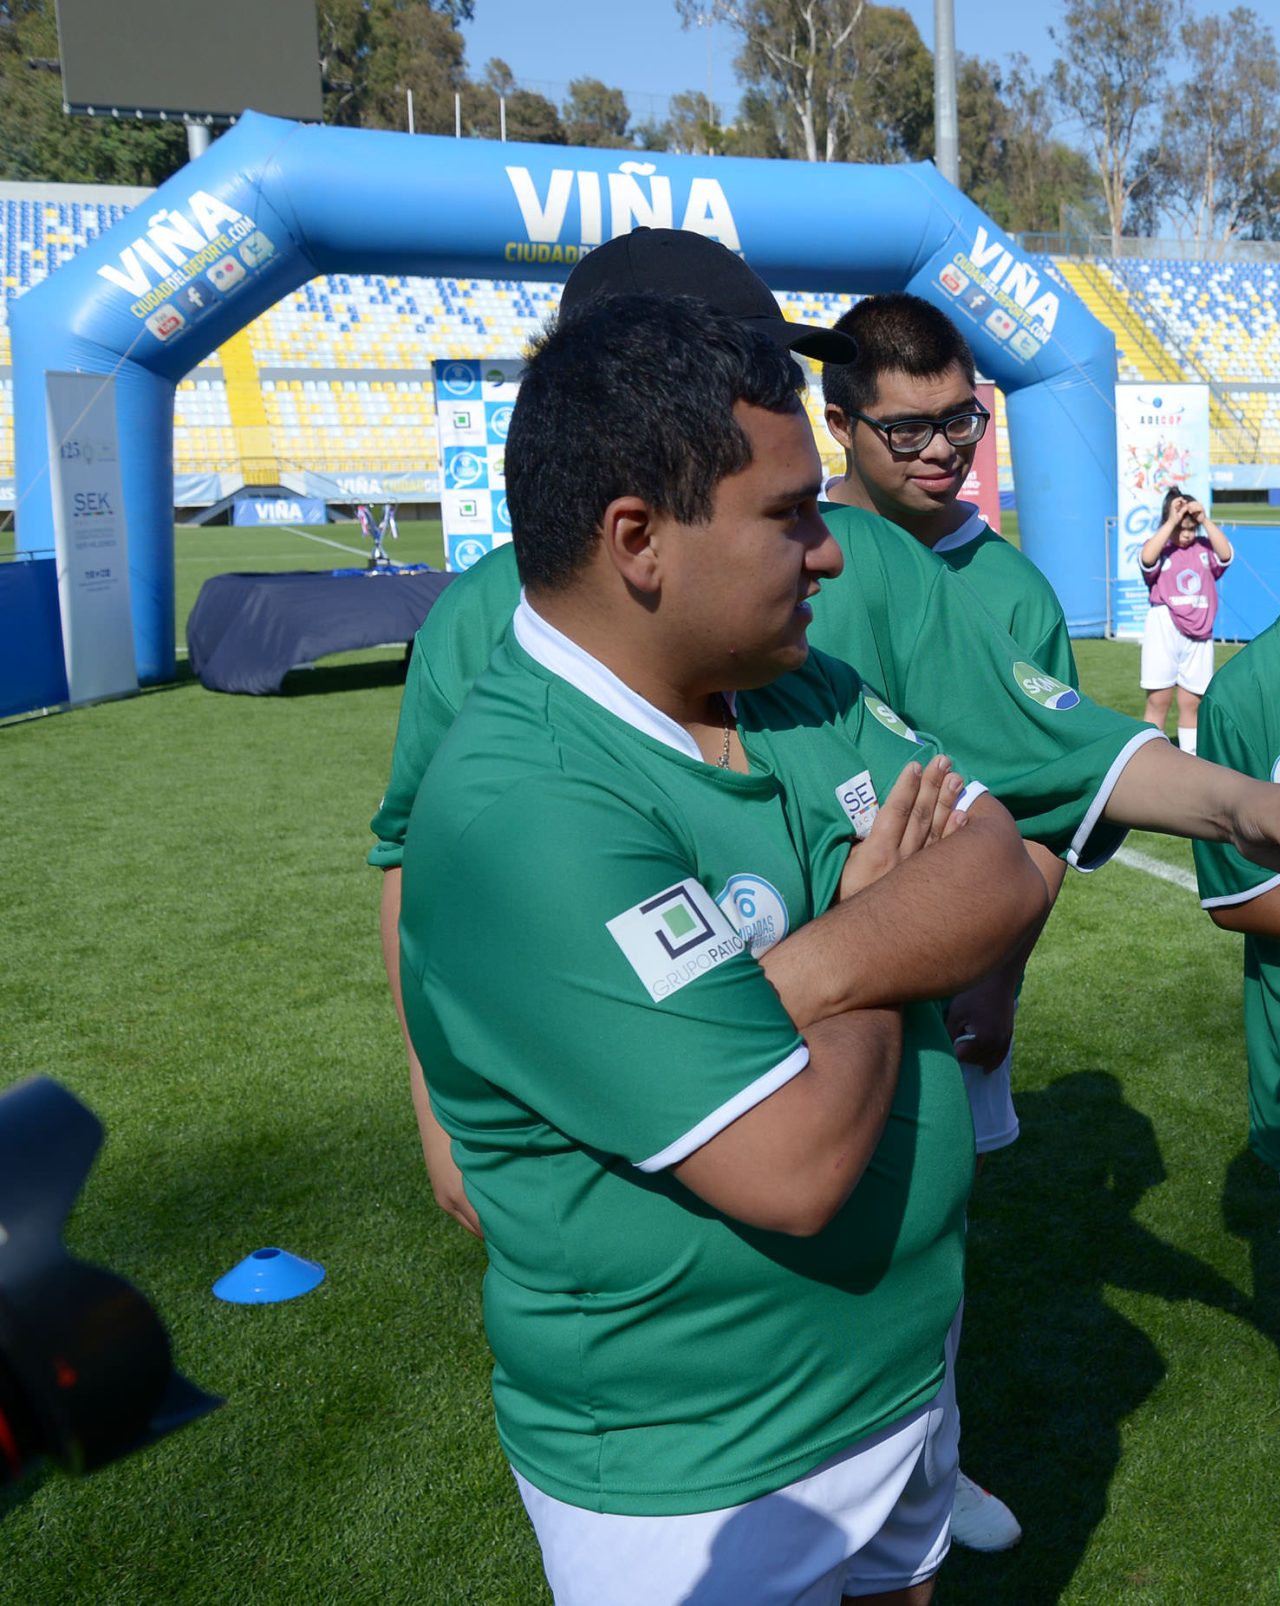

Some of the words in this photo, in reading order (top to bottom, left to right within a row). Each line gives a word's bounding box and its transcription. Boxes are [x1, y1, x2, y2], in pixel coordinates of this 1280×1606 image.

[505, 161, 742, 251] VIÑA
[97, 190, 243, 298] VIÑA
[969, 225, 1060, 343] VIÑA
[336, 476, 383, 495] VIÑA
[73, 492, 111, 511] SEK
[254, 499, 304, 521] VIÑA
[843, 782, 877, 813] SE
